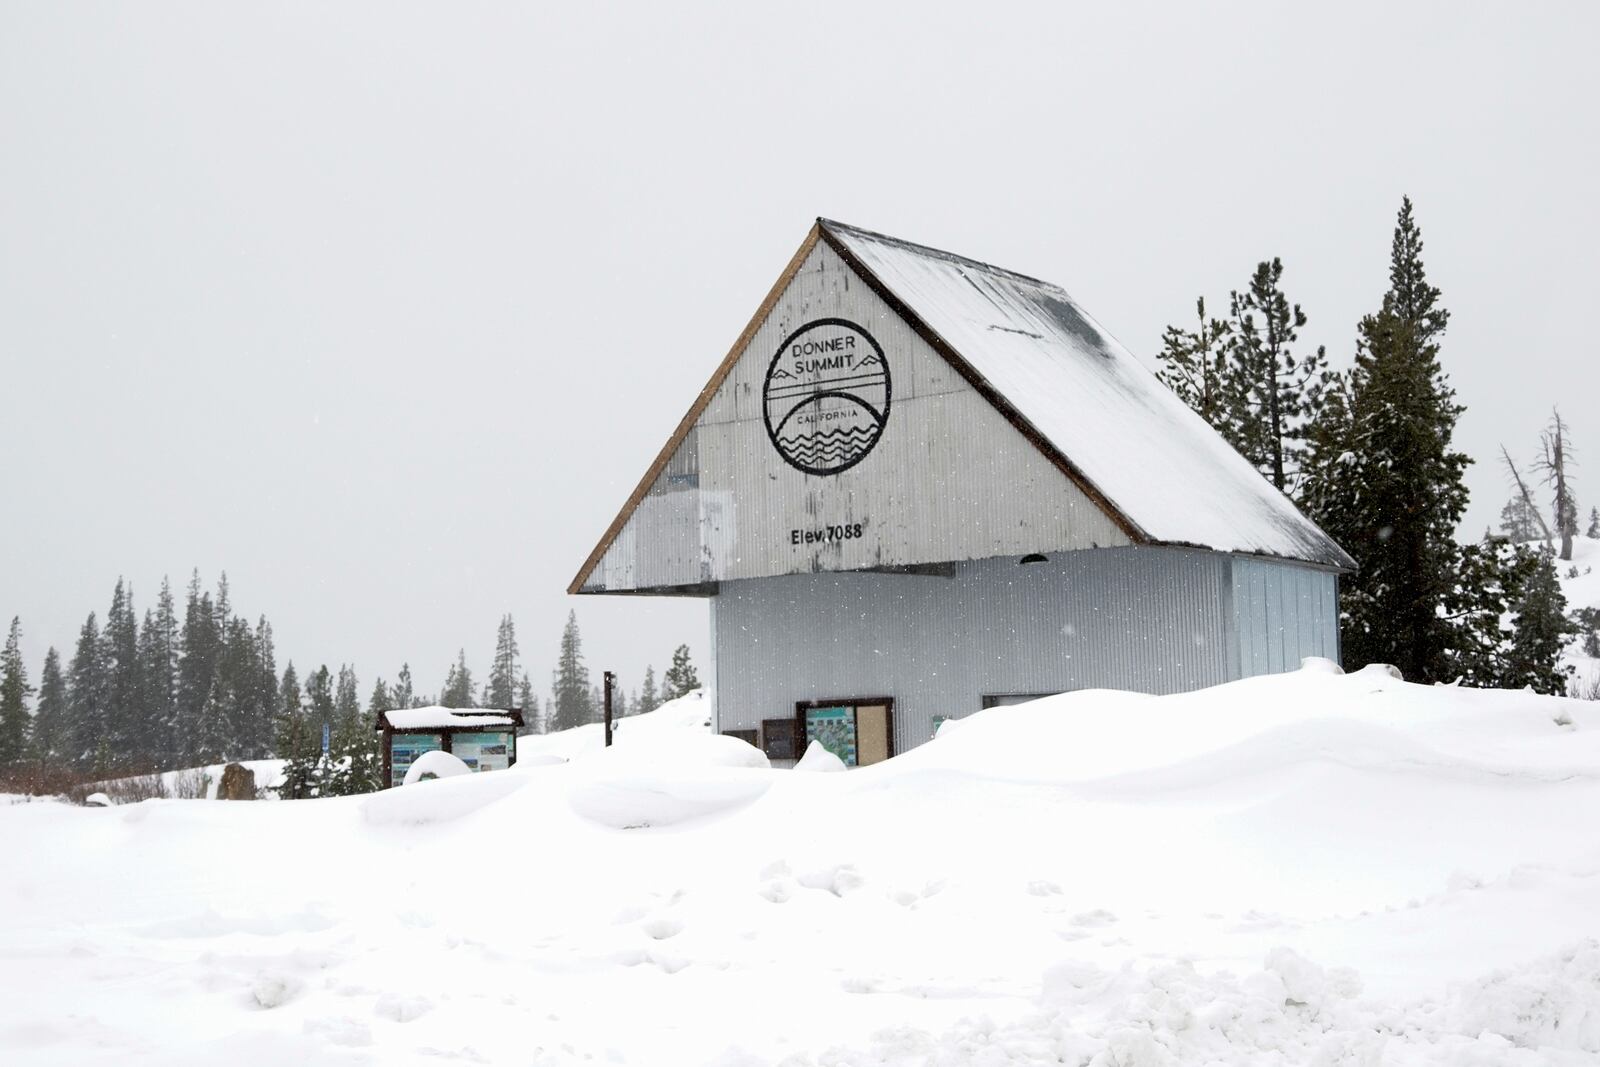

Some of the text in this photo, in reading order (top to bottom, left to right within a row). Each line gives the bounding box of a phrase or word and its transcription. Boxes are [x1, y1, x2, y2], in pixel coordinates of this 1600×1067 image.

[792, 336, 855, 357] DONNER
[795, 354, 854, 374] SUMMIT
[827, 523, 863, 542] 7088
